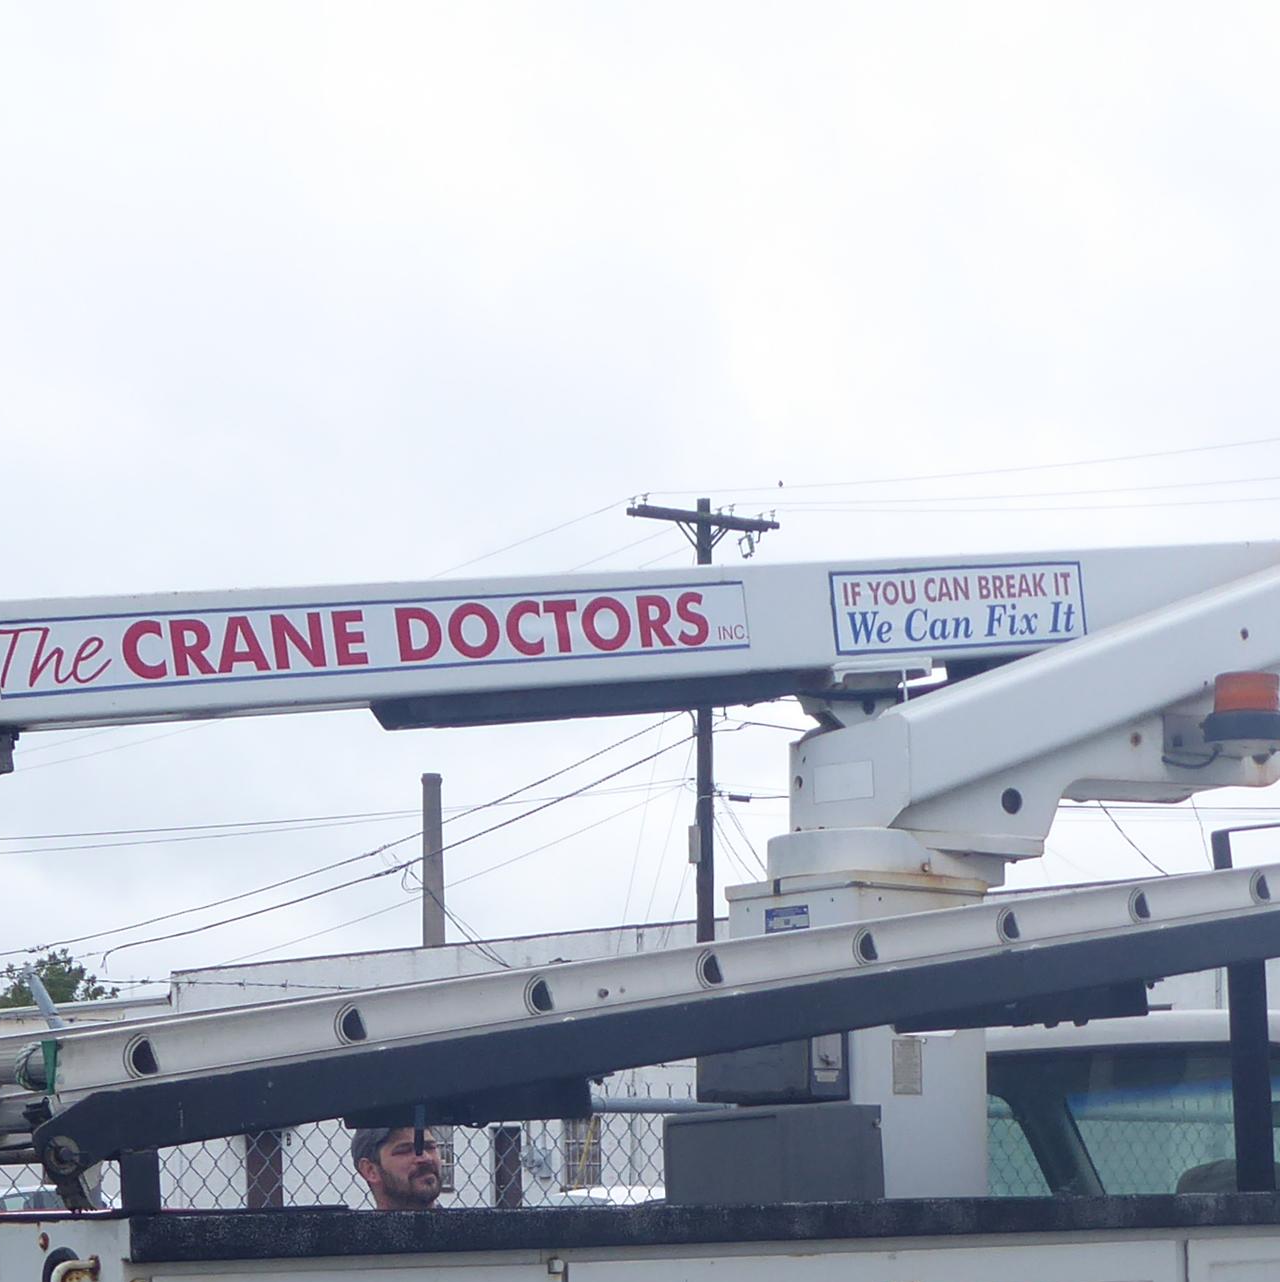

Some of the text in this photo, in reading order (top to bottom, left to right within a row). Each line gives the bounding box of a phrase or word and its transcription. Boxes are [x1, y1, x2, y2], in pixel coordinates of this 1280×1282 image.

[842, 572, 1071, 606] IF YOU CAN BREAK IT
[122, 609, 370, 681] CRANE
[394, 590, 711, 663] DOCTORS
[717, 623, 750, 641] INC.
[846, 601, 1076, 645] We Can Fix It
